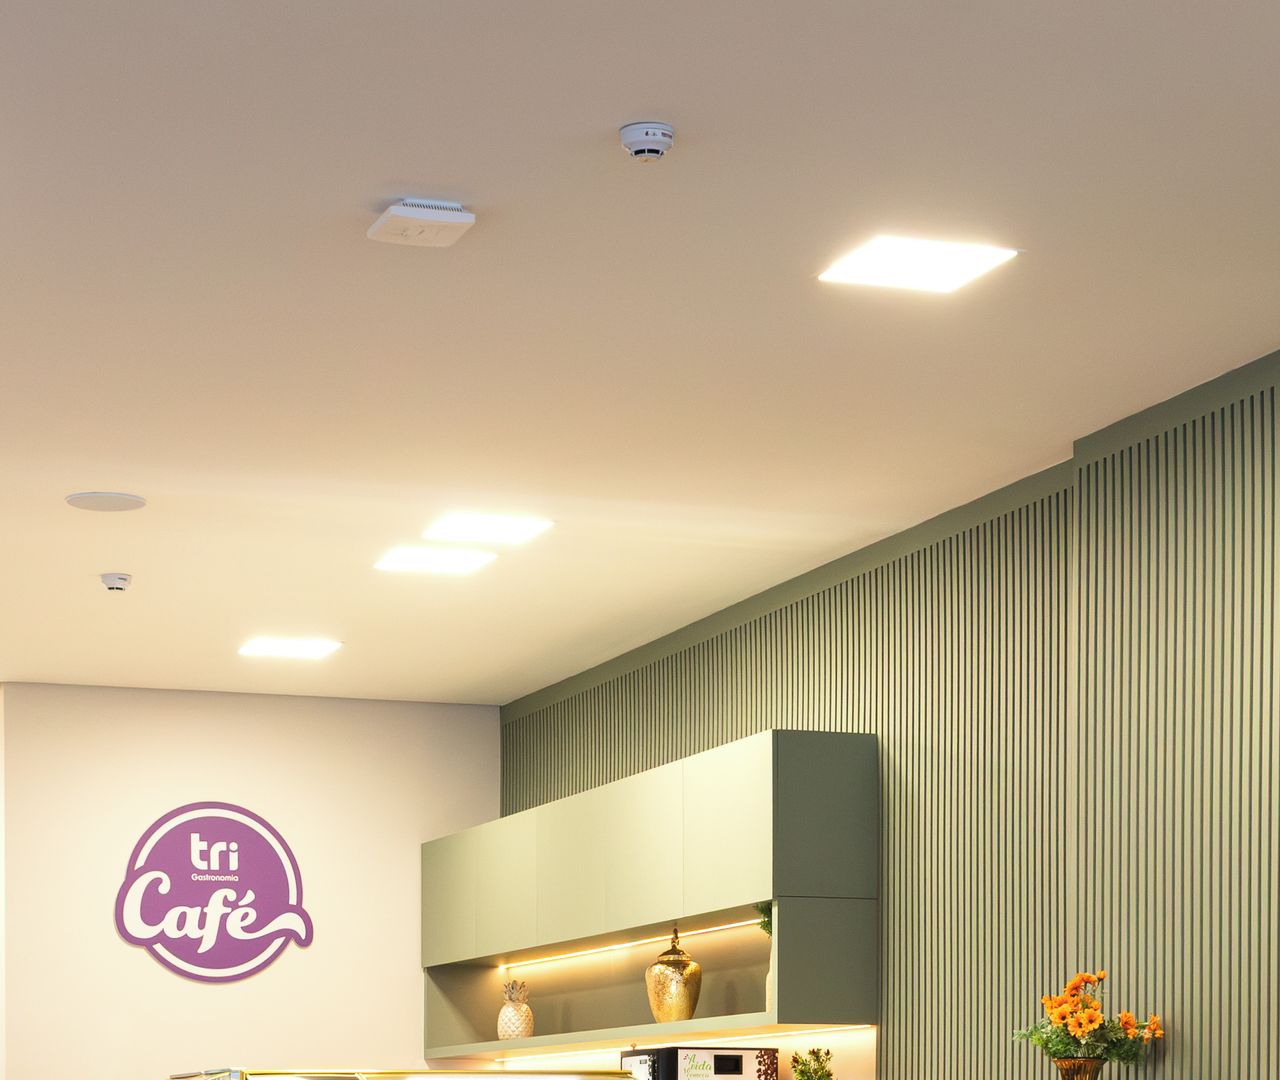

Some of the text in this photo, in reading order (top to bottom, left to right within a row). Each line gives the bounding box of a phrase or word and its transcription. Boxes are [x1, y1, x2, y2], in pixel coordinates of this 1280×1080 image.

[190, 832, 239, 871] tri
[191, 873, 239, 882] Gastronomia
[122, 870, 307, 954] Café
